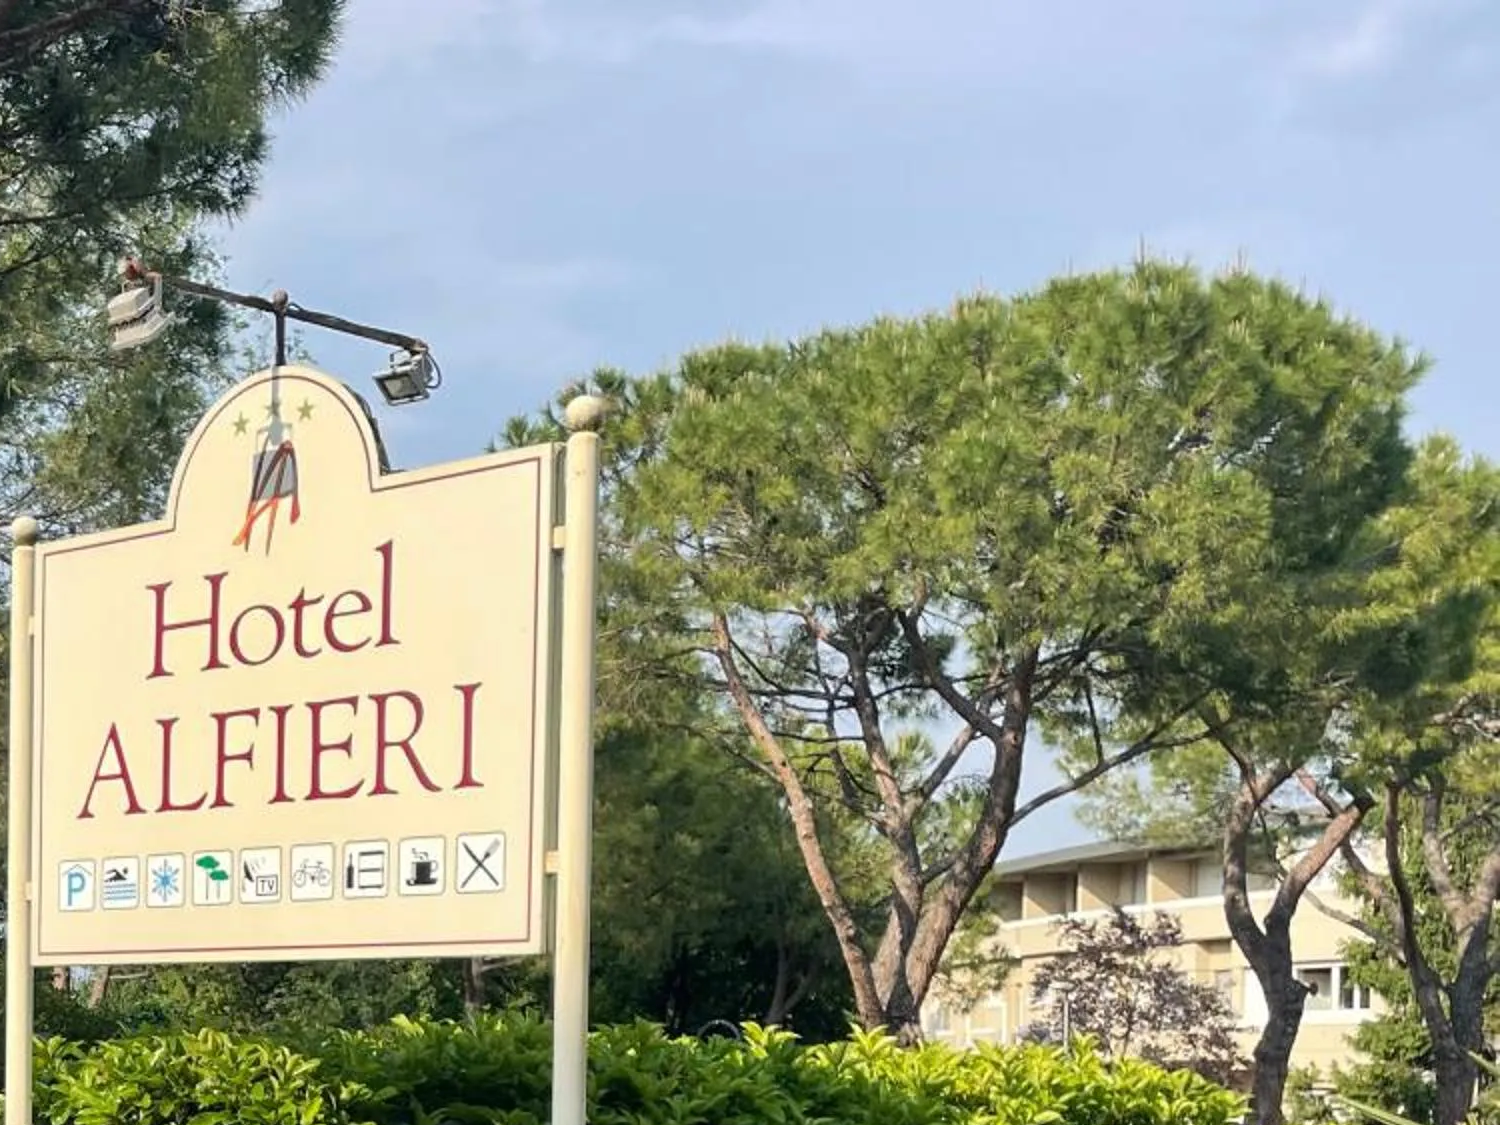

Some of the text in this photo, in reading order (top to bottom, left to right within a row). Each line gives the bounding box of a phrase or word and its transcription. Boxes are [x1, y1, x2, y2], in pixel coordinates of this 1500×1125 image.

[146, 539, 401, 681] Hotel
[76, 682, 485, 820] ALFIERI
[67, 872, 274, 906] P TV
